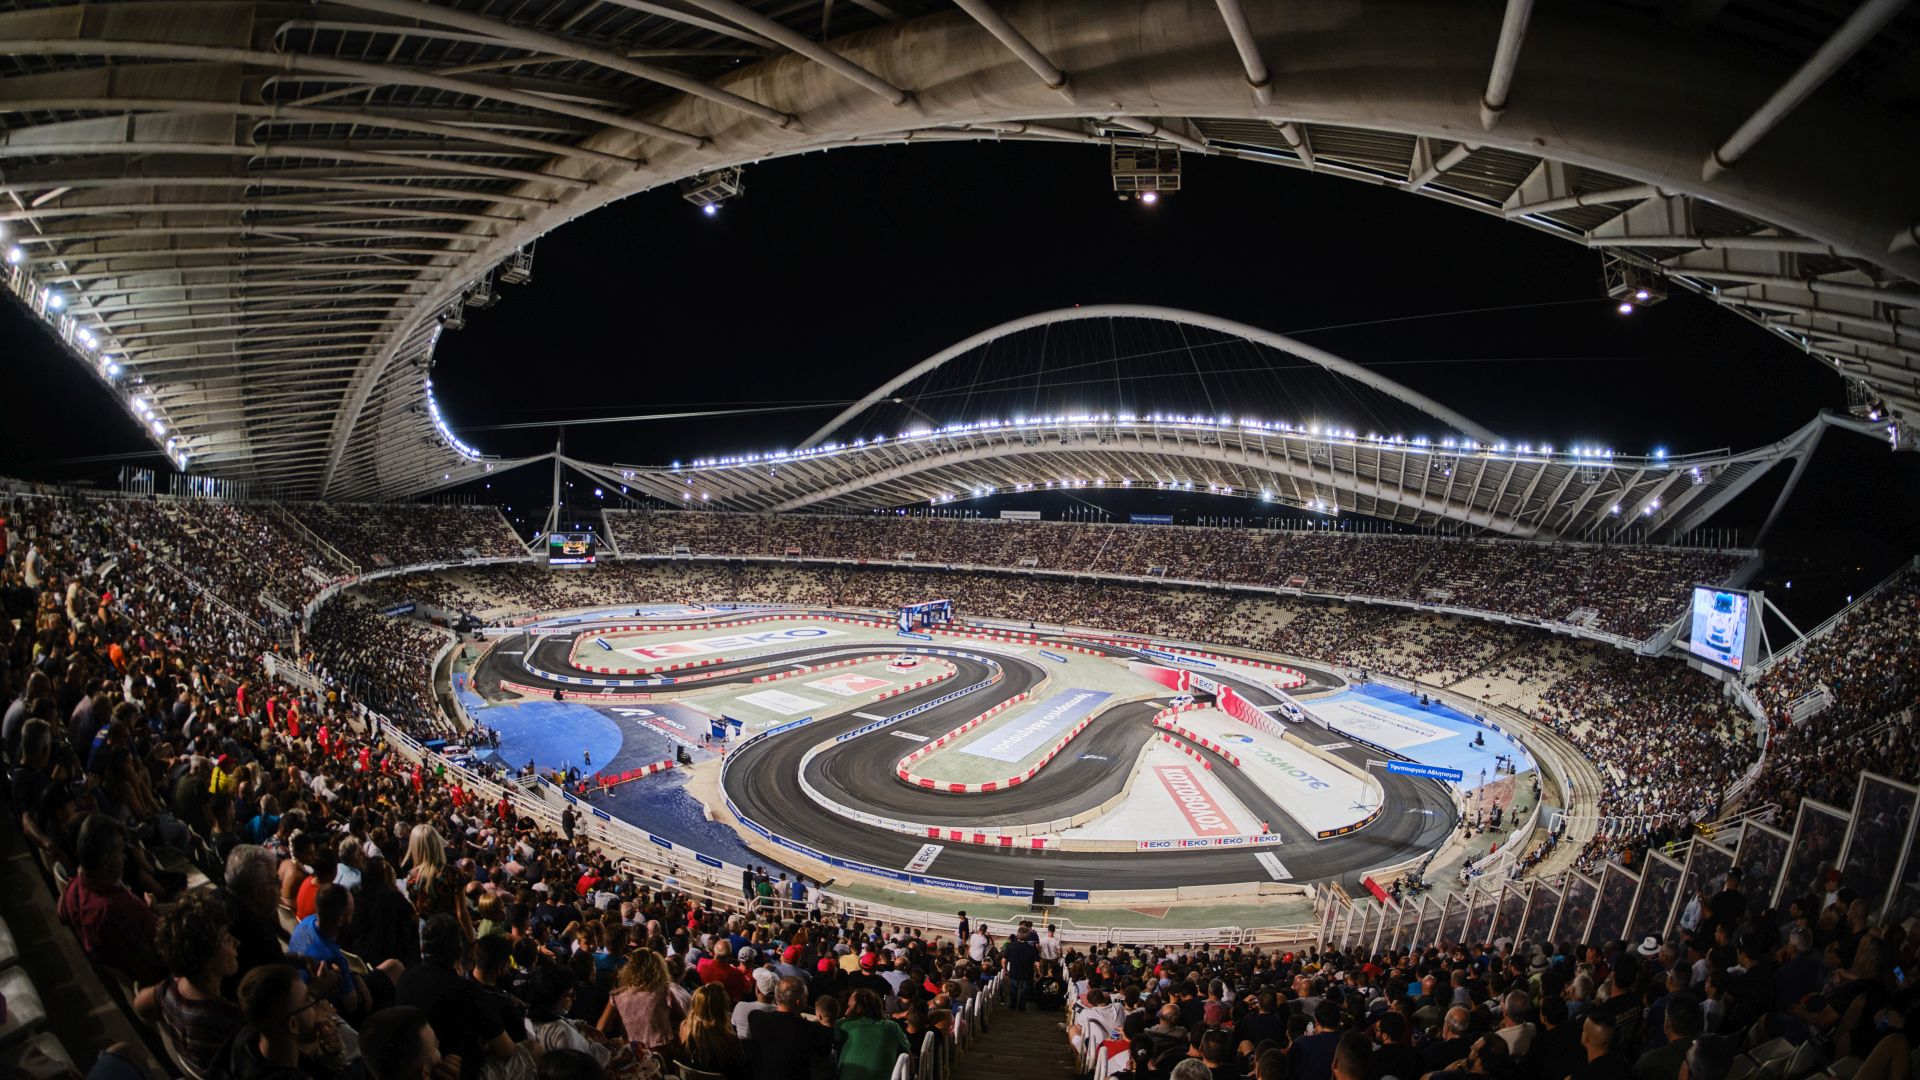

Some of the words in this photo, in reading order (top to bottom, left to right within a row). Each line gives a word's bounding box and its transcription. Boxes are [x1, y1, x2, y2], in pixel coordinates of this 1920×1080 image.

[699, 628, 828, 649] EKO
[1199, 679, 1214, 691] EKO
[1390, 764, 1427, 774] Υφυπουργείο
[1427, 769, 1461, 779] Αθλητισμού
[1187, 839, 1208, 847] EKO
[1223, 837, 1243, 845] EKO
[1258, 835, 1278, 843] EKO
[918, 846, 937, 862] EKO
[923, 878, 956, 889] Υφυπουργείο
